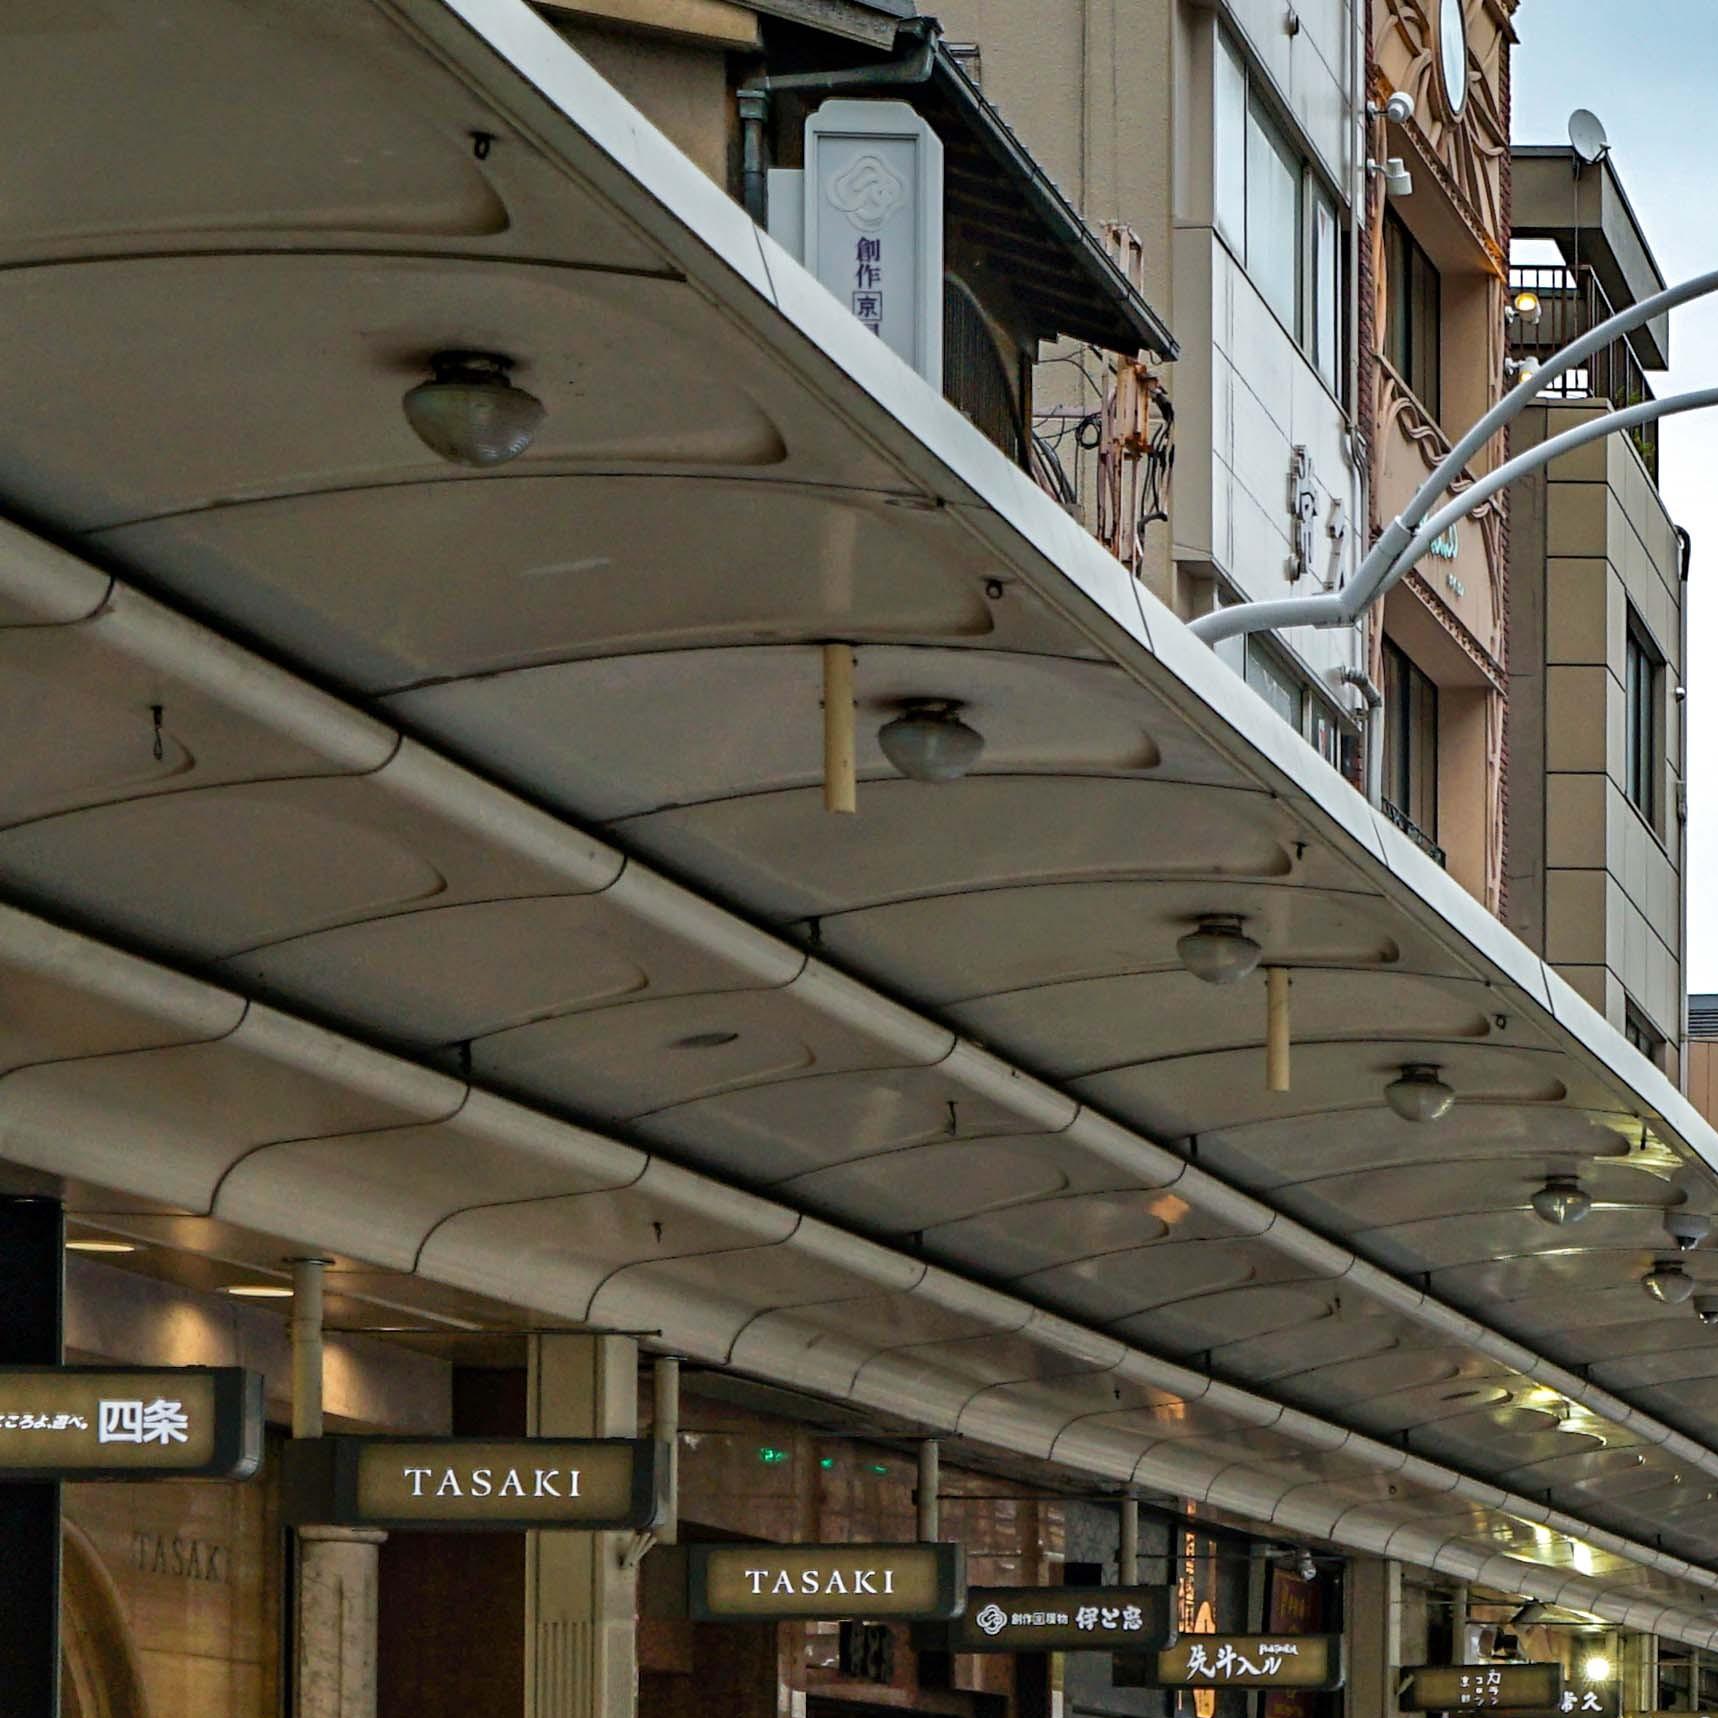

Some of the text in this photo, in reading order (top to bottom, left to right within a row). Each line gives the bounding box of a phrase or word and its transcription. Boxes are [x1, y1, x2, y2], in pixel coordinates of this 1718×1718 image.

[855, 236, 881, 338] 創作京
[0, 1398, 189, 1444] ころよ、遊べ。 四条
[404, 1469, 582, 1497] TASAKI
[745, 1570, 895, 1594] TASAKI
